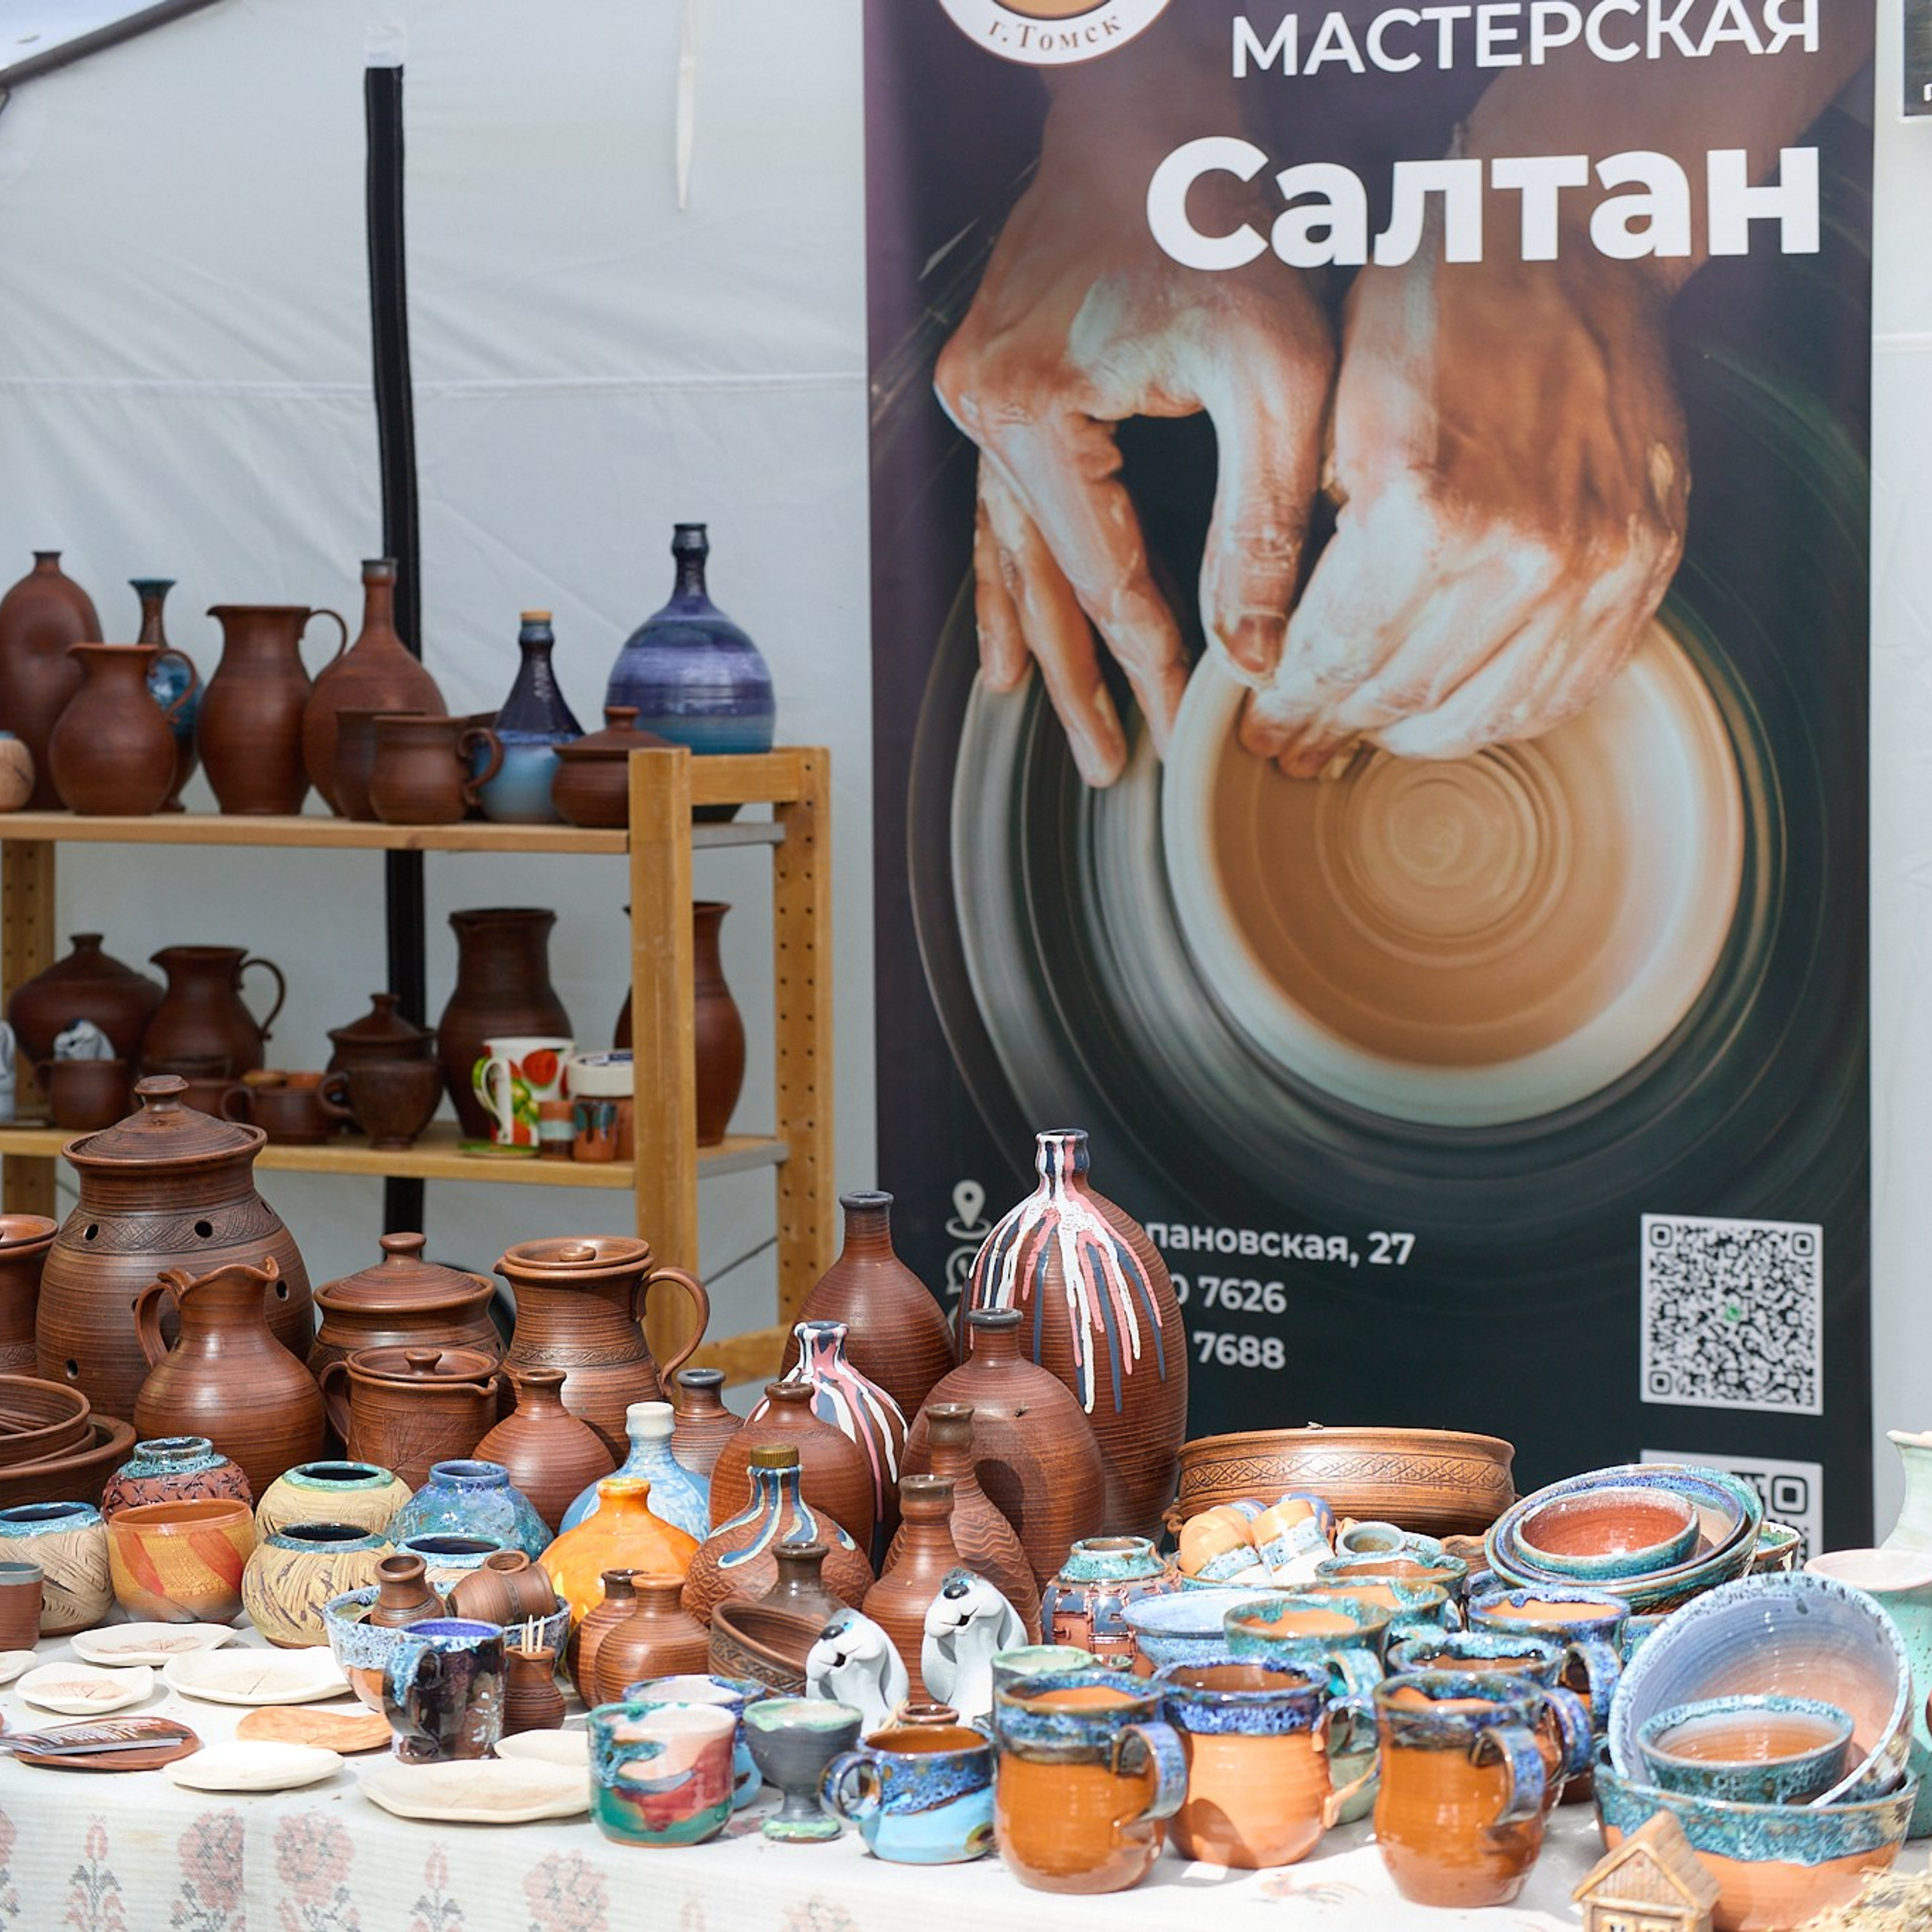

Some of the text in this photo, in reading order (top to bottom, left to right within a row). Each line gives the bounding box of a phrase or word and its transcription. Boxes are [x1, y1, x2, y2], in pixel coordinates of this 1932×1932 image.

[1232, 0, 1819, 78] МАСТЕРСКАЯ
[1146, 137, 1820, 270] Салтан
[1367, 1231, 1416, 1265] 27
[1197, 1275, 1287, 1314] 7626
[1192, 1331, 1286, 1370] 7688
